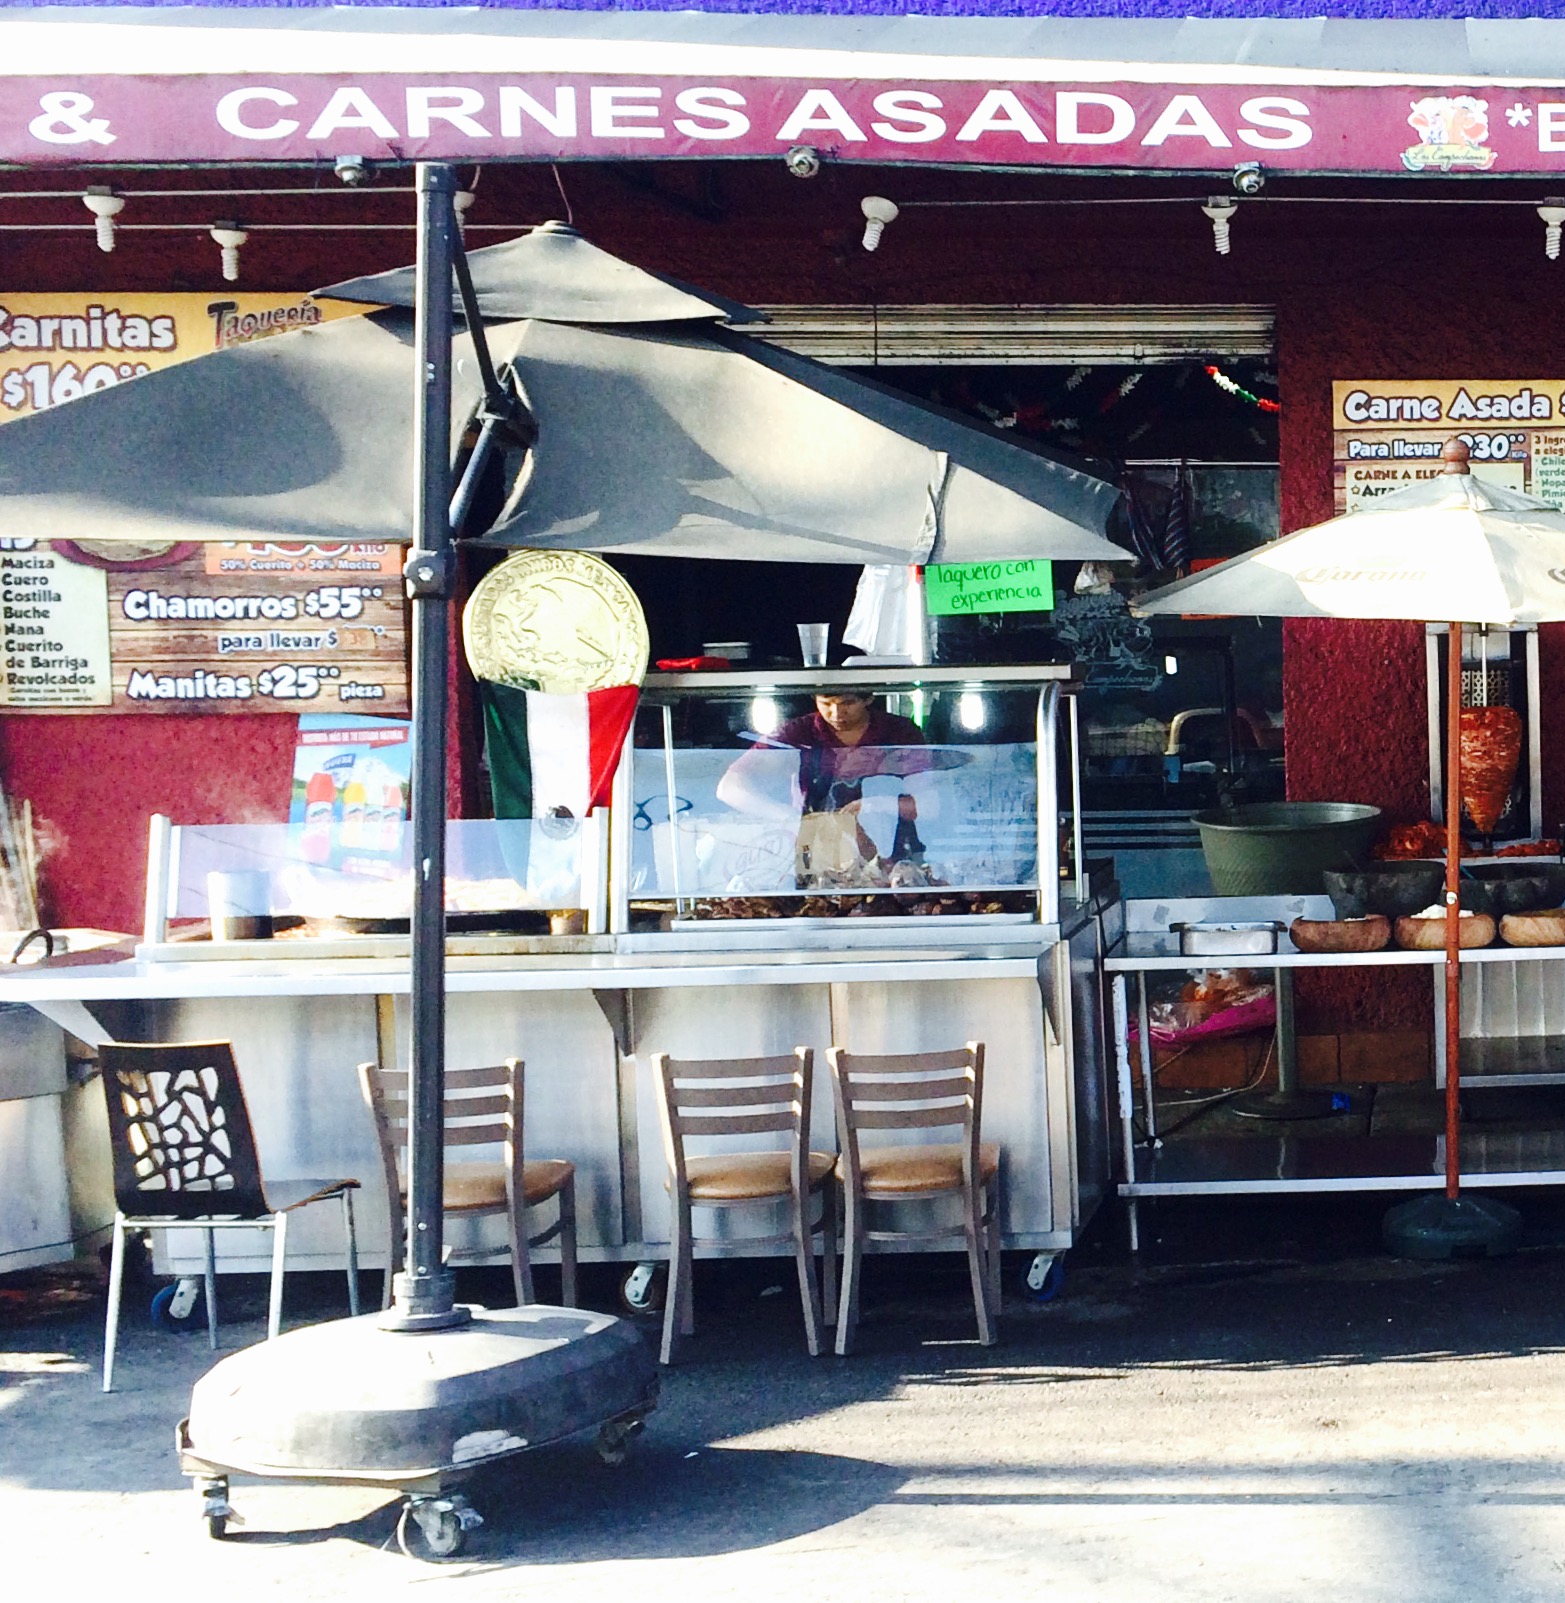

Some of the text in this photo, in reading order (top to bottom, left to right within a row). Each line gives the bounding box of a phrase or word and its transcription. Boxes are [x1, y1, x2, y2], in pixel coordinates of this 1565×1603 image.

[29, 86, 1314, 149] & CARNES ASADAS
[1344, 389, 1442, 423] Carne
[1448, 387, 1552, 422] Asada
[1534, 435, 1542, 445] 3
[1348, 439, 1389, 459] Para
[1393, 438, 1443, 459] llevar
[1510, 450, 1529, 459] Kilo
[1534, 447, 1541, 455] a
[1353, 469, 1398, 481] CARNE
[1401, 469, 1412, 480] A
[1, 556, 55, 569] Maciza
[220, 559, 247, 571] 50%
[250, 558, 293, 571] Cuerito
[309, 559, 334, 571] 50%
[338, 558, 381, 571] Maciza
[1006, 560, 1035, 576] con
[1, 572, 49, 586] Cuero
[2, 589, 62, 602] Costilla
[951, 586, 1043, 611] experiencia
[123, 588, 298, 620] Chamorros
[3, 606, 51, 619] Buche
[4, 622, 45, 636] Nana
[5, 639, 64, 652] Cuerito
[220, 635, 263, 652] para
[270, 633, 322, 649] llevar
[6, 655, 88, 672] de Barriga
[7, 672, 96, 685] Revolcados
[126, 668, 254, 701] Manitas
[340, 681, 384, 701] pieza
